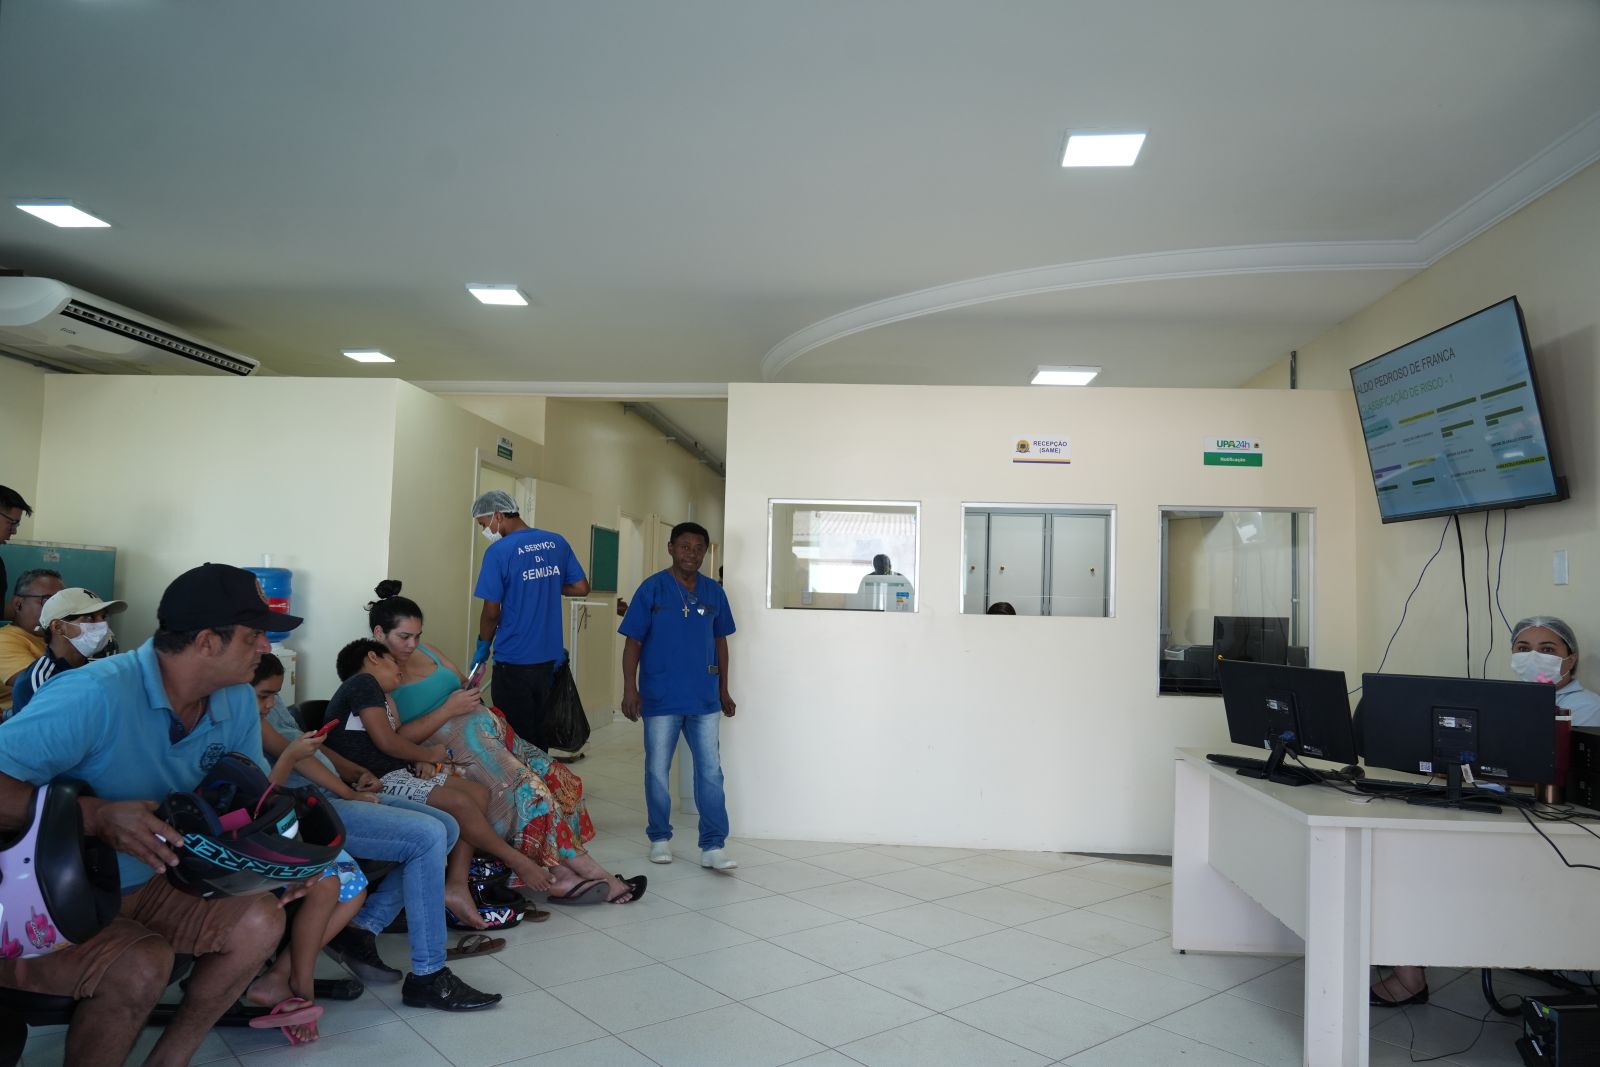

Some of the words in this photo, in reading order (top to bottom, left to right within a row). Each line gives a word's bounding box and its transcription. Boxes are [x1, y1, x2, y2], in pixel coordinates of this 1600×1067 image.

[1374, 366, 1409, 388] PEDROSO
[1409, 361, 1421, 375] DE
[1409, 385, 1420, 398] DE
[1419, 377, 1444, 394] RISCO
[518, 547, 524, 555] A
[524, 541, 556, 552] SERVIÇO
[522, 565, 561, 581] SEMUSA
